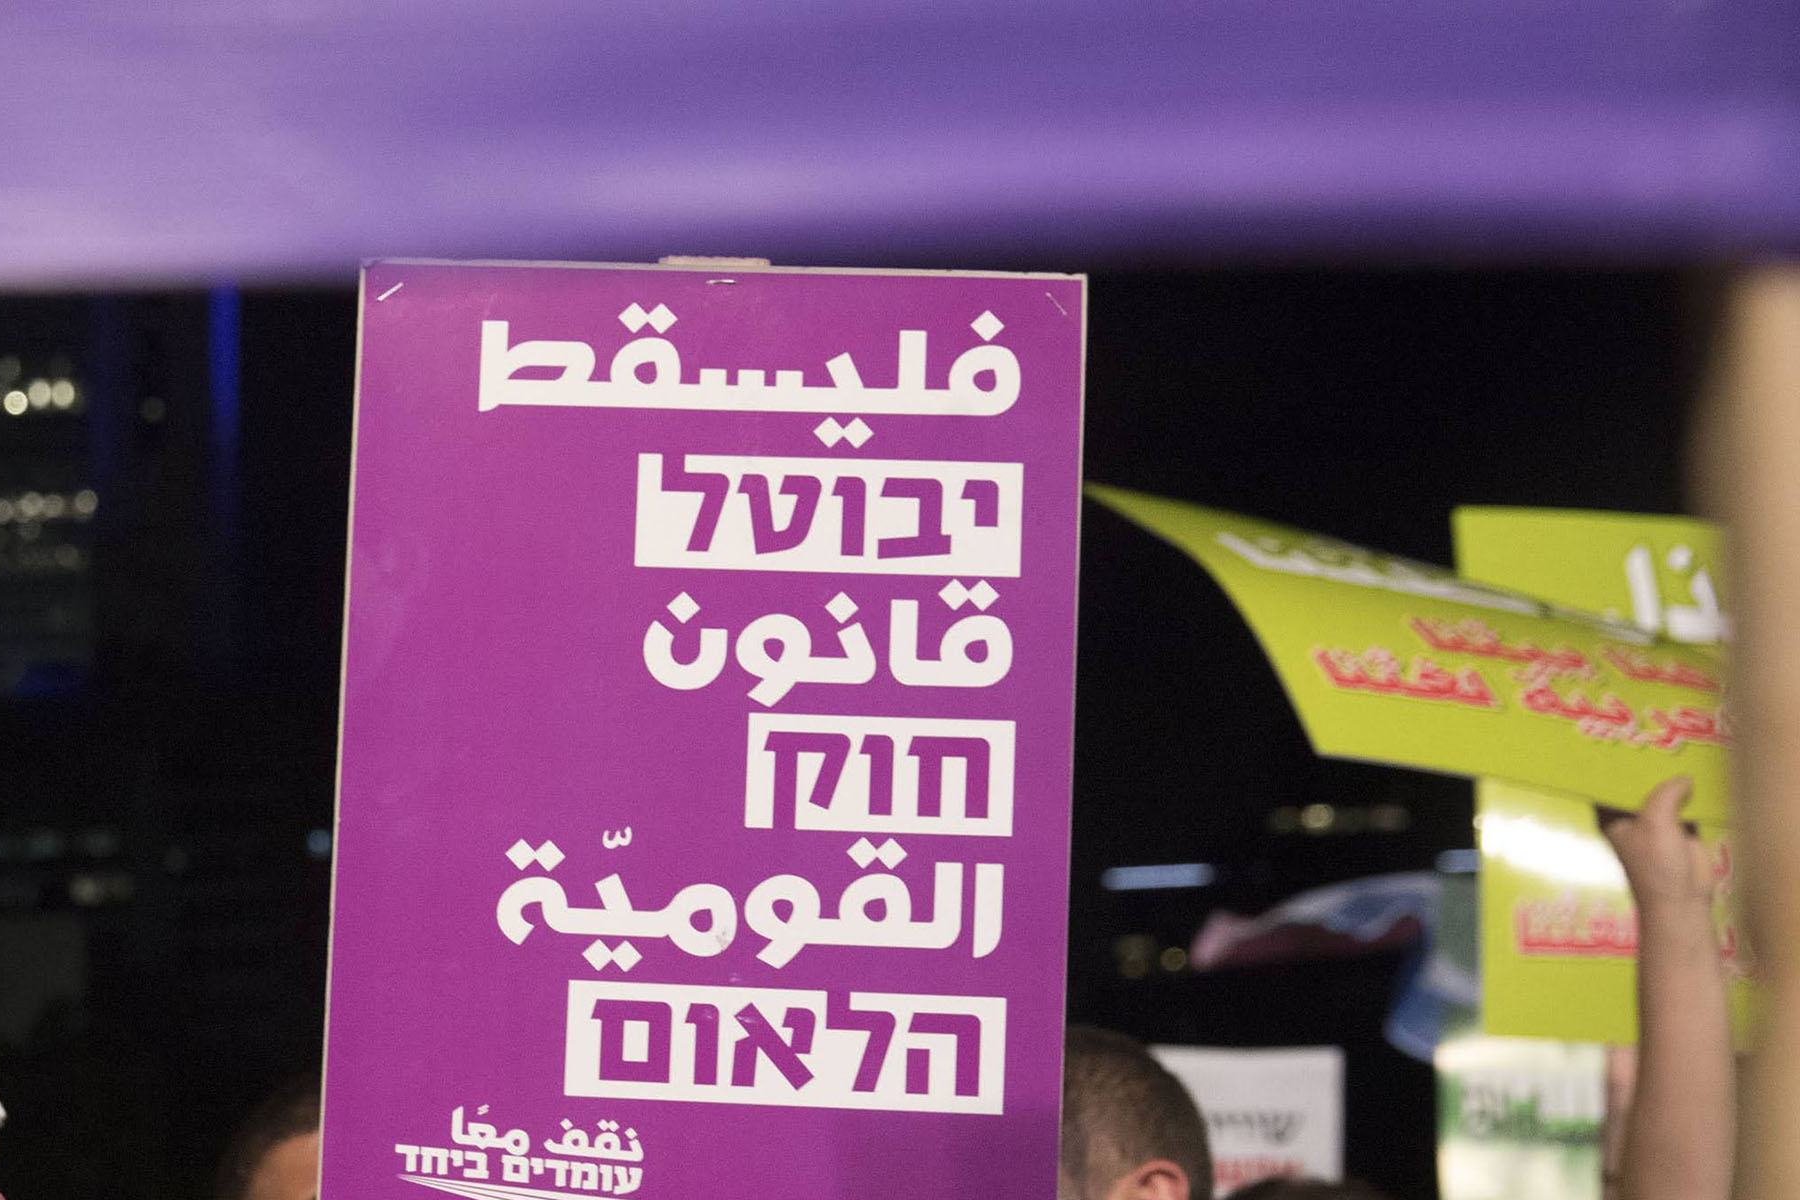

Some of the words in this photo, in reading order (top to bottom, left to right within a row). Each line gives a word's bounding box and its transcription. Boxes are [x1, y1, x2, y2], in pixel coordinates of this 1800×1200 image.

[478, 302, 1022, 449] فليسقط
[659, 455, 1000, 562] יבושל
[642, 578, 1015, 708] قانون
[760, 729, 991, 829] חוק
[591, 993, 980, 1100] הלאום
[394, 1143, 490, 1180] ביחד
[501, 1154, 644, 1195] עומדים
[543, 1118, 644, 1162] نقف
